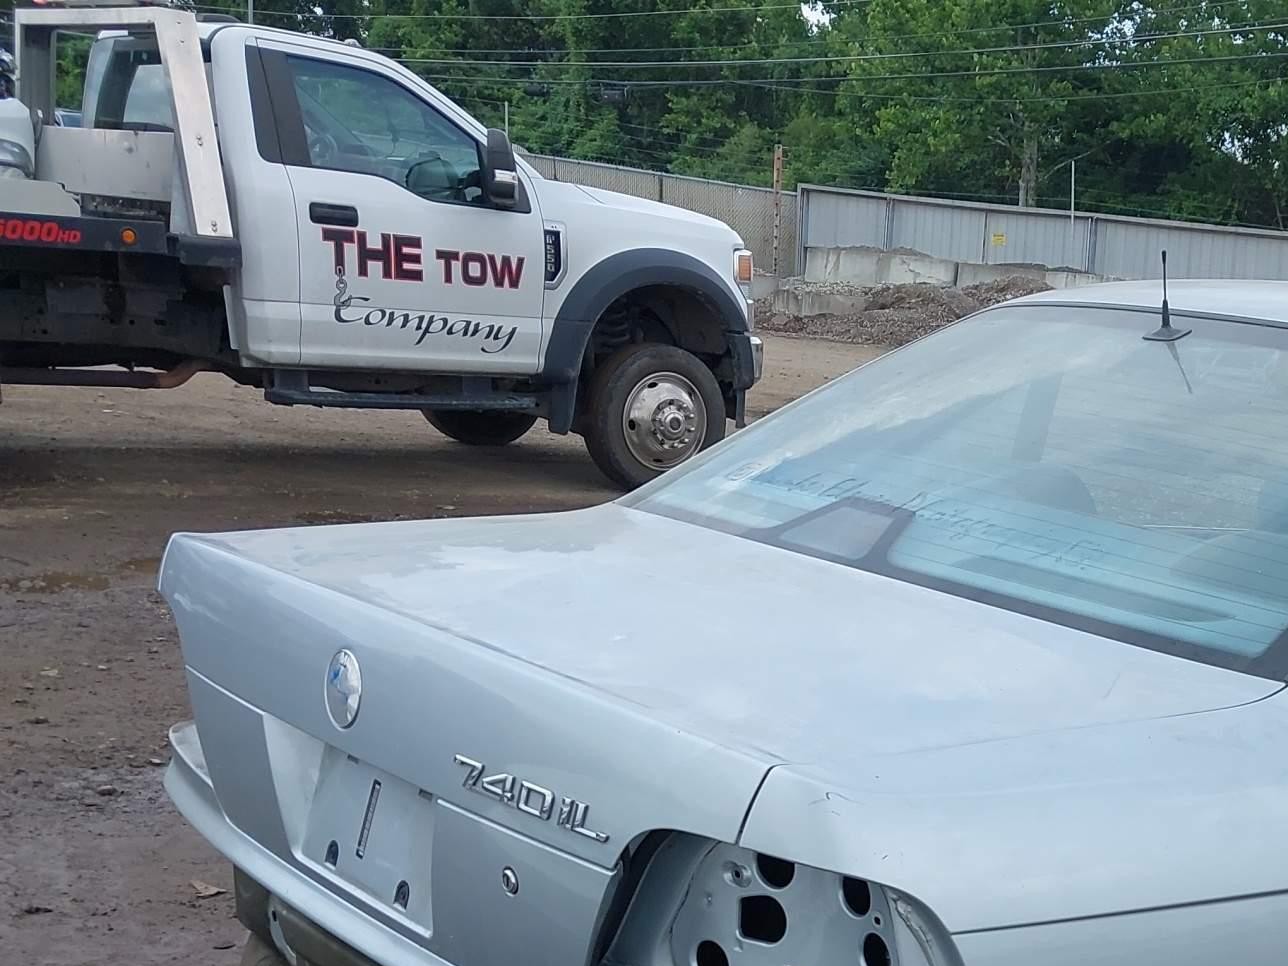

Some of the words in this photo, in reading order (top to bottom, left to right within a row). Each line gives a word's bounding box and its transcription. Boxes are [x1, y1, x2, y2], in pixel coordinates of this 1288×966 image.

[0, 219, 80, 243] 000HD
[321, 226, 424, 283] THE
[434, 248, 526, 290] TOW
[333, 294, 518, 354] Company
